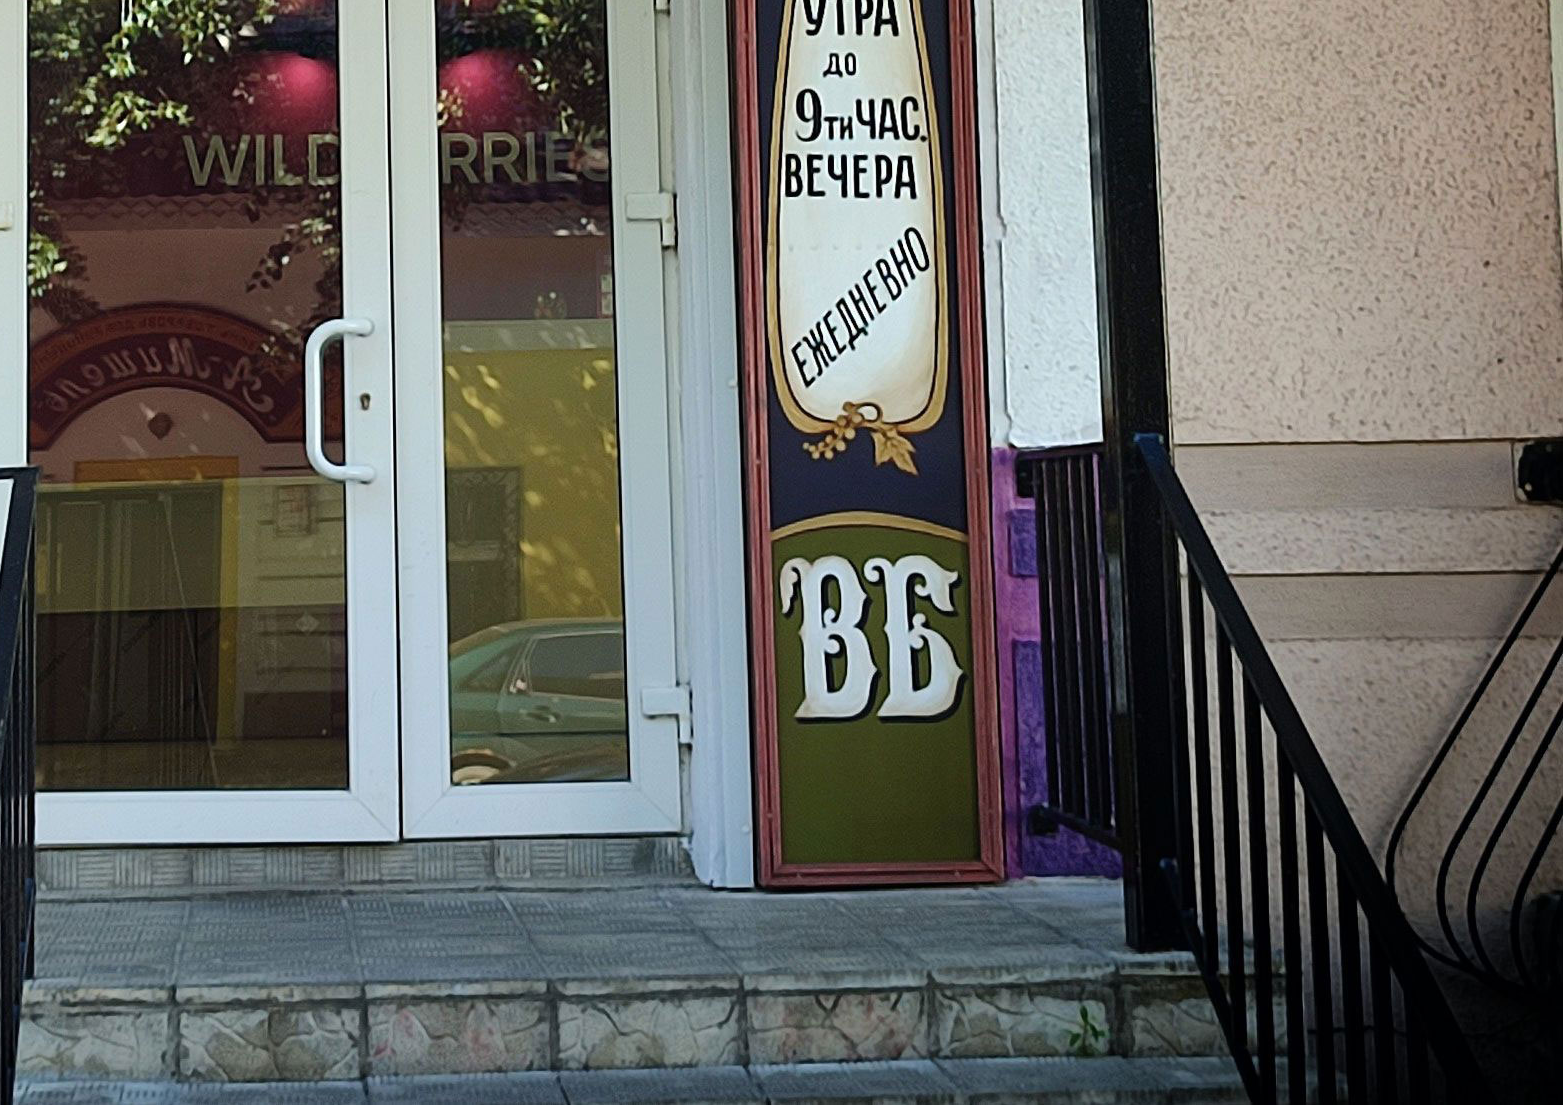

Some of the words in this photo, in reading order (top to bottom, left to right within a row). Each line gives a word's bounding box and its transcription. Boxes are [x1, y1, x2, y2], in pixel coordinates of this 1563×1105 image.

[855, 96, 928, 142] ЧАС.
[784, 153, 917, 199] ВЕЧЕРА
[791, 227, 930, 388] ЕЖЕДНЕВНО
[780, 555, 964, 719] ВБ
